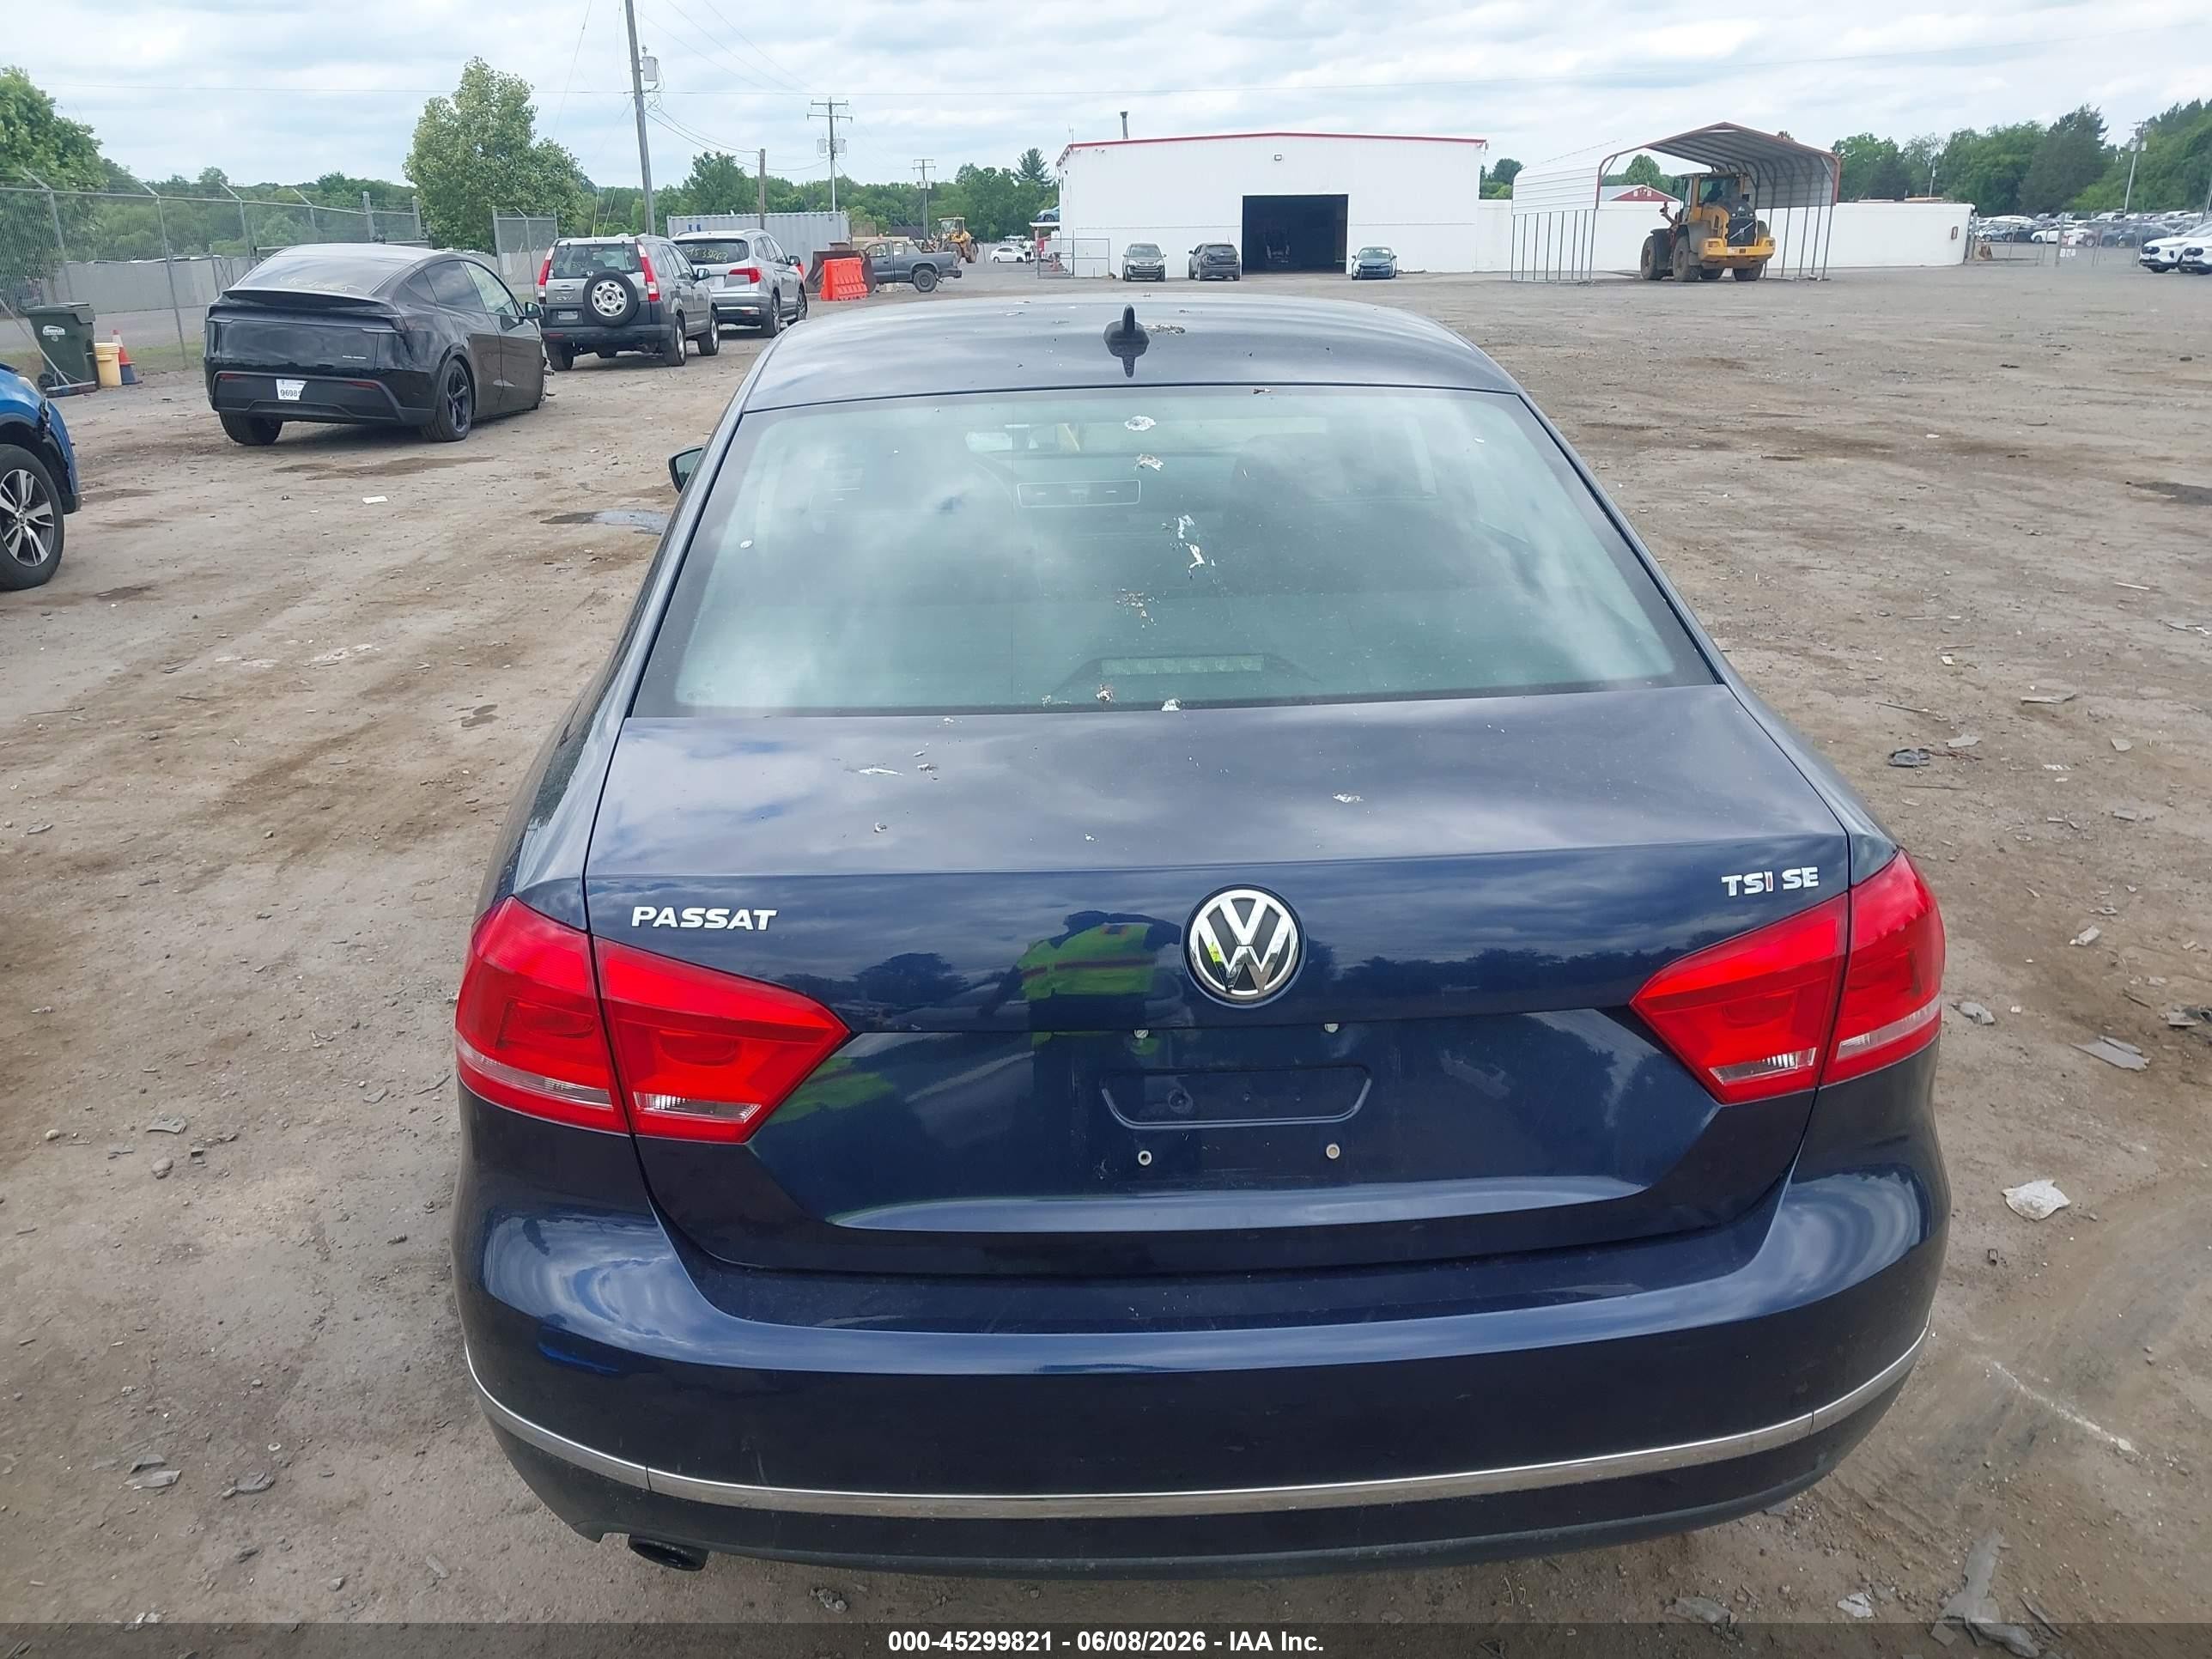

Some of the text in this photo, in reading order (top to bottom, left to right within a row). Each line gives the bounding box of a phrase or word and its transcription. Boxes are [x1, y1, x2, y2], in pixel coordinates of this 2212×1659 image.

[1721, 866, 1820, 896] TSI SE
[631, 906, 778, 930] PASSAT
[1189, 889, 1299, 1001] VW
